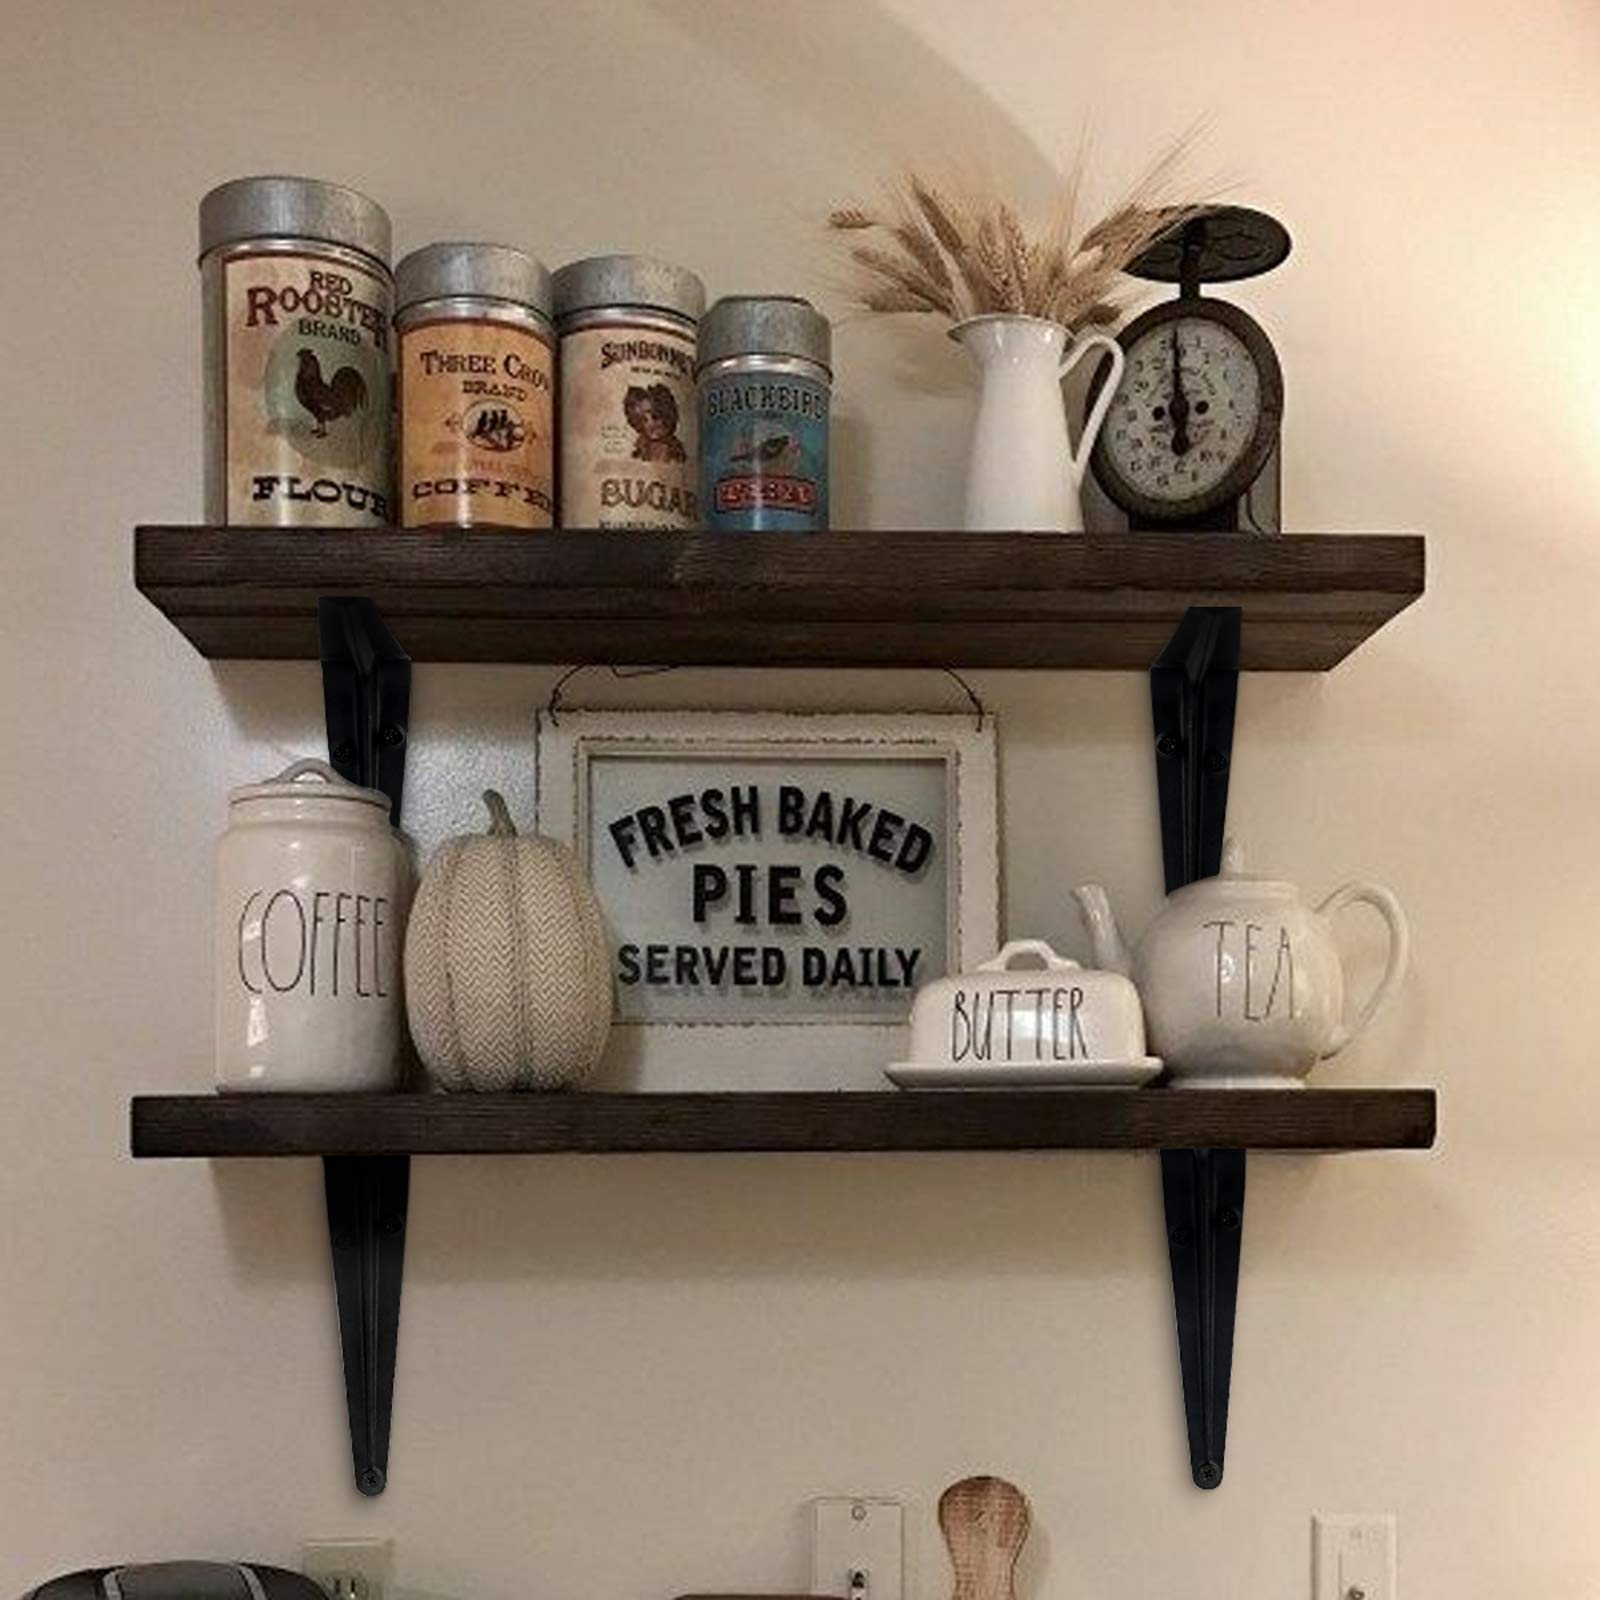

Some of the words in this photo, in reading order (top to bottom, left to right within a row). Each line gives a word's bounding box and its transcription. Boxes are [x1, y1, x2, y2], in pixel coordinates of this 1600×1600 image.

[309, 270, 354, 296] RED
[246, 286, 389, 354] ROOSTER
[298, 318, 362, 346] BRAND
[419, 350, 496, 376] THREE
[252, 475, 388, 519] FLOUR
[608, 785, 760, 868] FRESH
[778, 785, 934, 874] BAKED
[692, 862, 848, 926] PIES
[237, 888, 389, 997] COFFEE
[617, 945, 788, 987] SERVED
[802, 946, 922, 988] DAILY
[1202, 920, 1295, 1022] TEA
[951, 986, 1090, 1064] BUTTER
